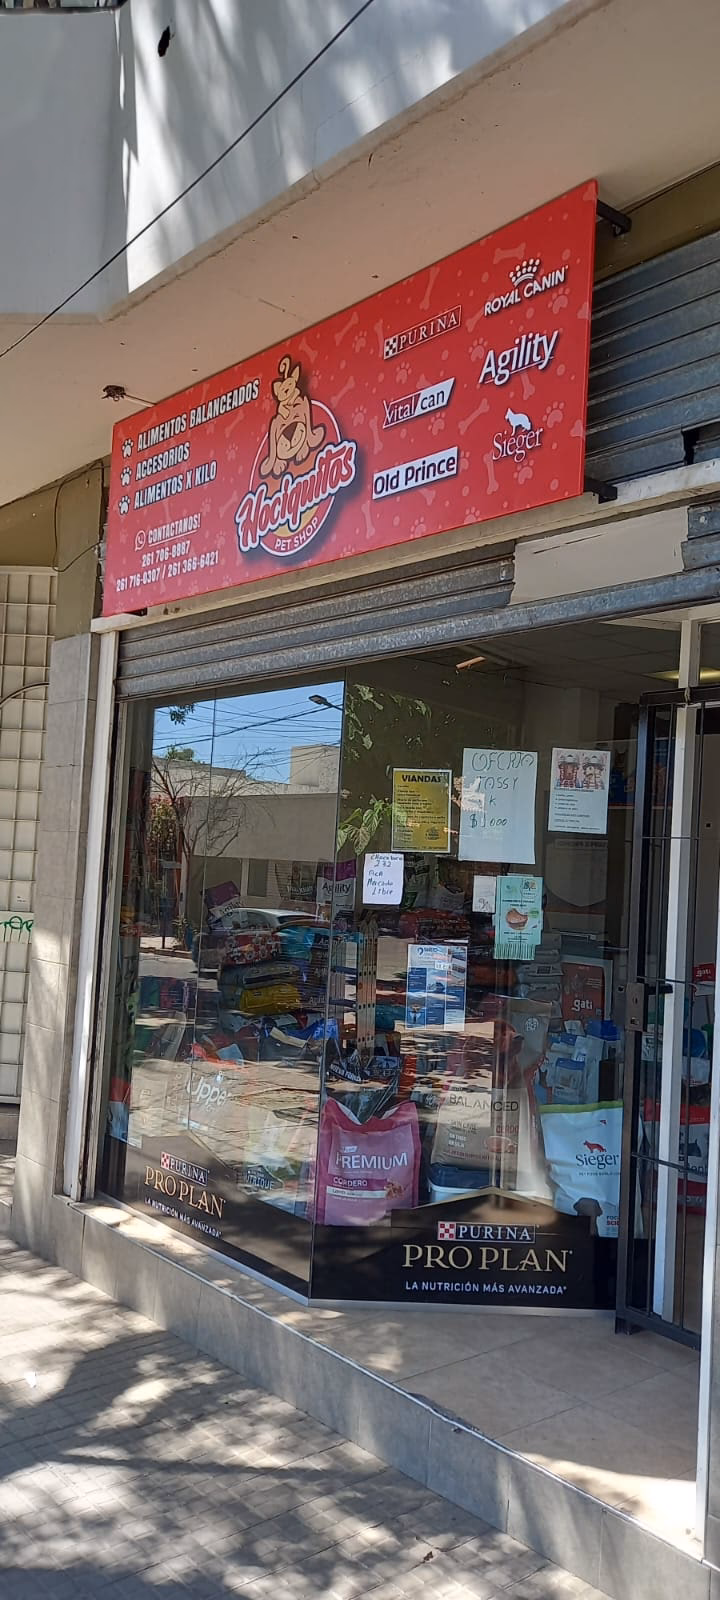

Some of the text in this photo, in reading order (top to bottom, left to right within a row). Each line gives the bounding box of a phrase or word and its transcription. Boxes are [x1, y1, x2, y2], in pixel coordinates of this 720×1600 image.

[484, 267, 565, 316] ROYAL CANIN
[399, 312, 458, 350] PURINA
[478, 331, 558, 386] Agility
[137, 378, 260, 452] ALIMENTOS BALANCEADOS
[383, 389, 445, 423] Vital can
[135, 441, 190, 481] ACCESORIOS
[492, 427, 544, 463] Sieger
[133, 460, 217, 510] ALIMENTOS X KILO
[374, 457, 456, 496] Old Prince
[148, 512, 201, 544] CONTACTANOS!
[274, 517, 319, 551] PET SHOP
[142, 540, 190, 568] 261 706-8887
[116, 578, 128, 592] 261
[129, 567, 160, 588] 716-0307
[167, 562, 180, 578] 261
[182, 550, 219, 573] 366-6421
[401, 774, 441, 783] VIANDAS
[571, 999, 593, 1012] gati
[449, 1093, 519, 1112] BALANCED
[170, 1157, 206, 1183] PURINA
[335, 1152, 408, 1170] PREMIUM
[575, 1154, 620, 1170] Sieger
[333, 1176, 368, 1188] CORDERO
[458, 1224, 532, 1241] PURINA
[402, 1244, 570, 1273] PRO PLAN
[405, 1280, 418, 1291] LA
[421, 1280, 480, 1293] NUTRICIÓN
[482, 1282, 505, 1294] MÁS
